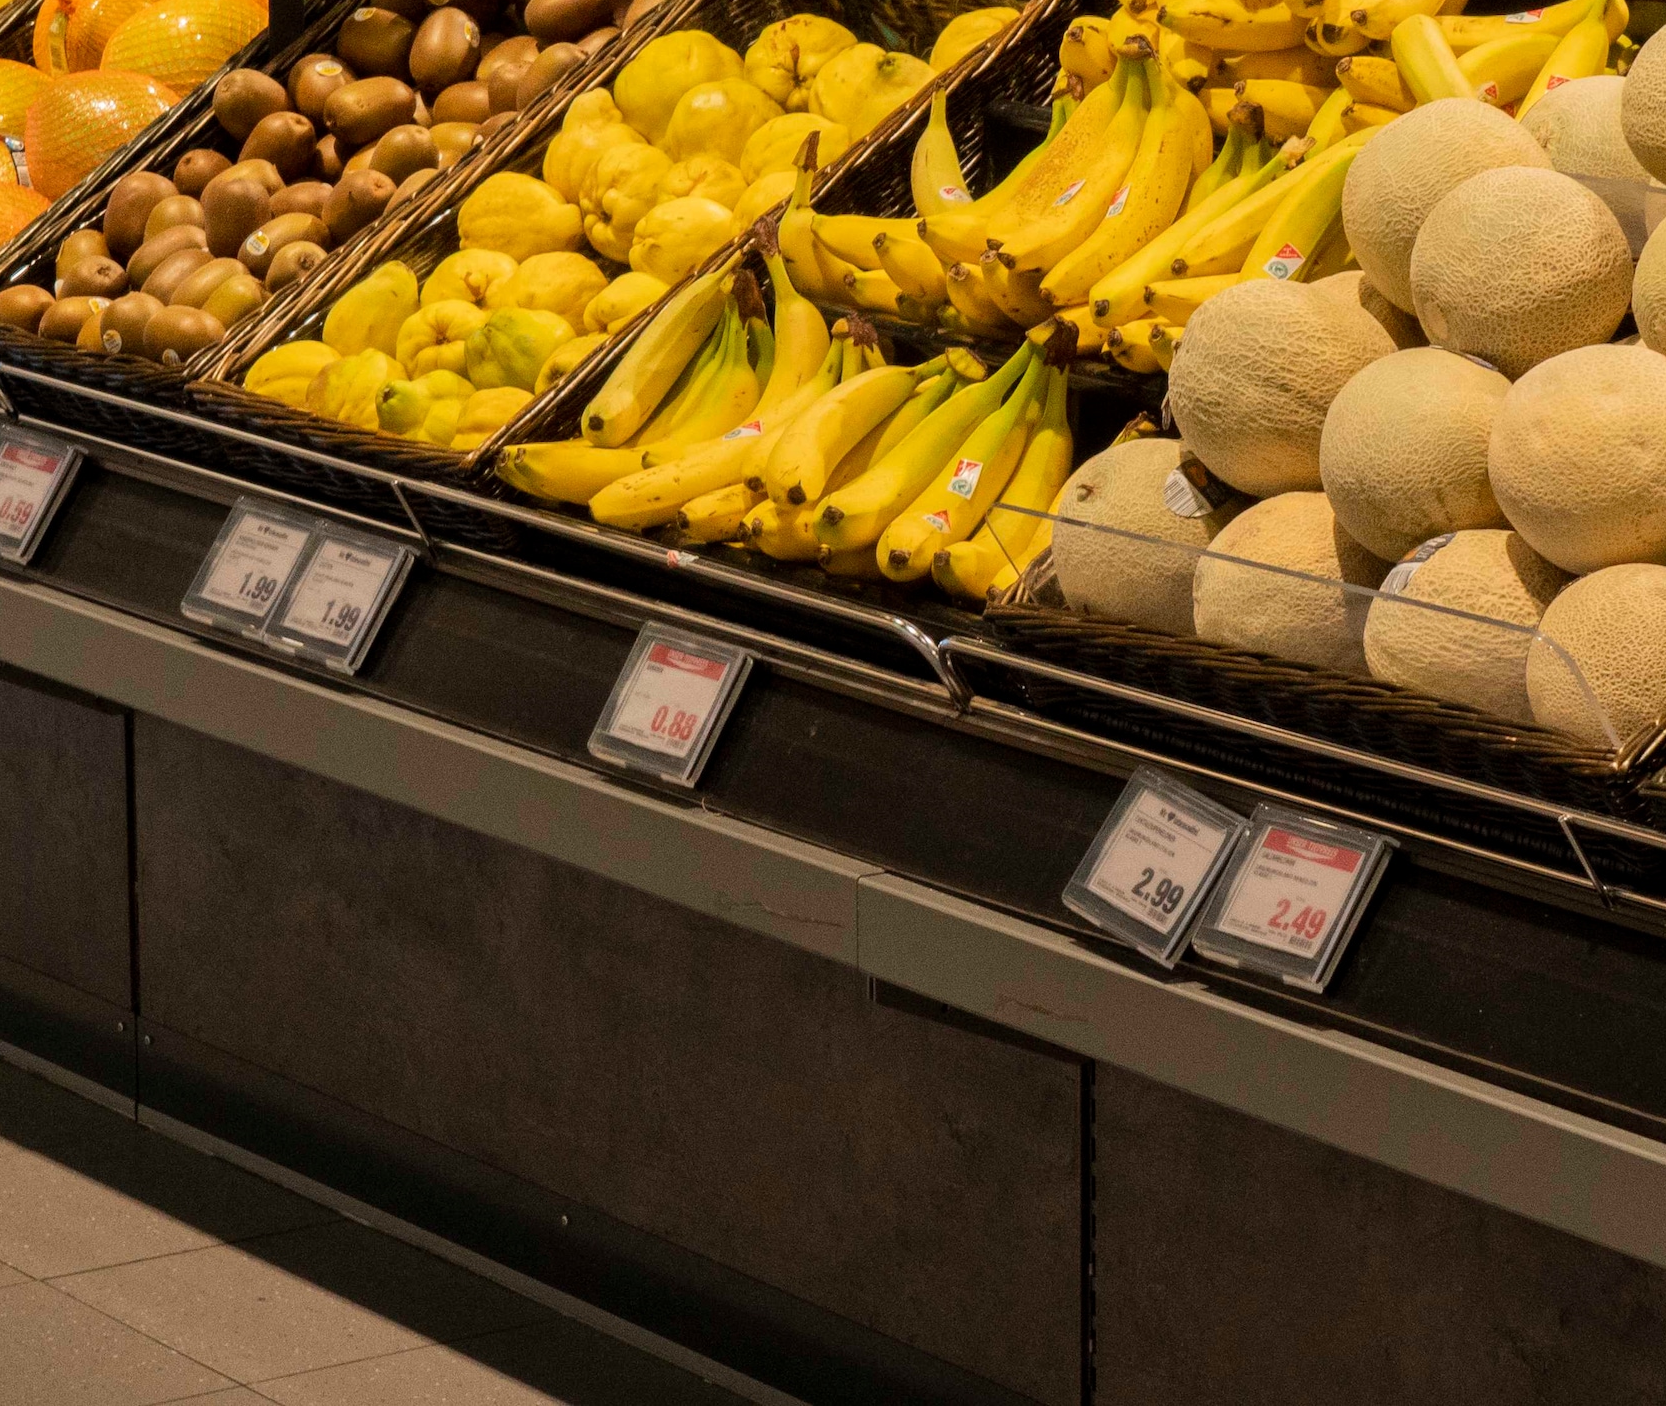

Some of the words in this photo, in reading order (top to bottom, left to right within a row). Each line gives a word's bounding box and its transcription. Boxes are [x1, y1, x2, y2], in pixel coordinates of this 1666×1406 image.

[237, 570, 279, 602] 1.99
[319, 599, 363, 632] 1.99
[650, 705, 699, 741] 0.88
[1131, 866, 1185, 915] 2.99
[1267, 898, 1327, 941] 2.49
